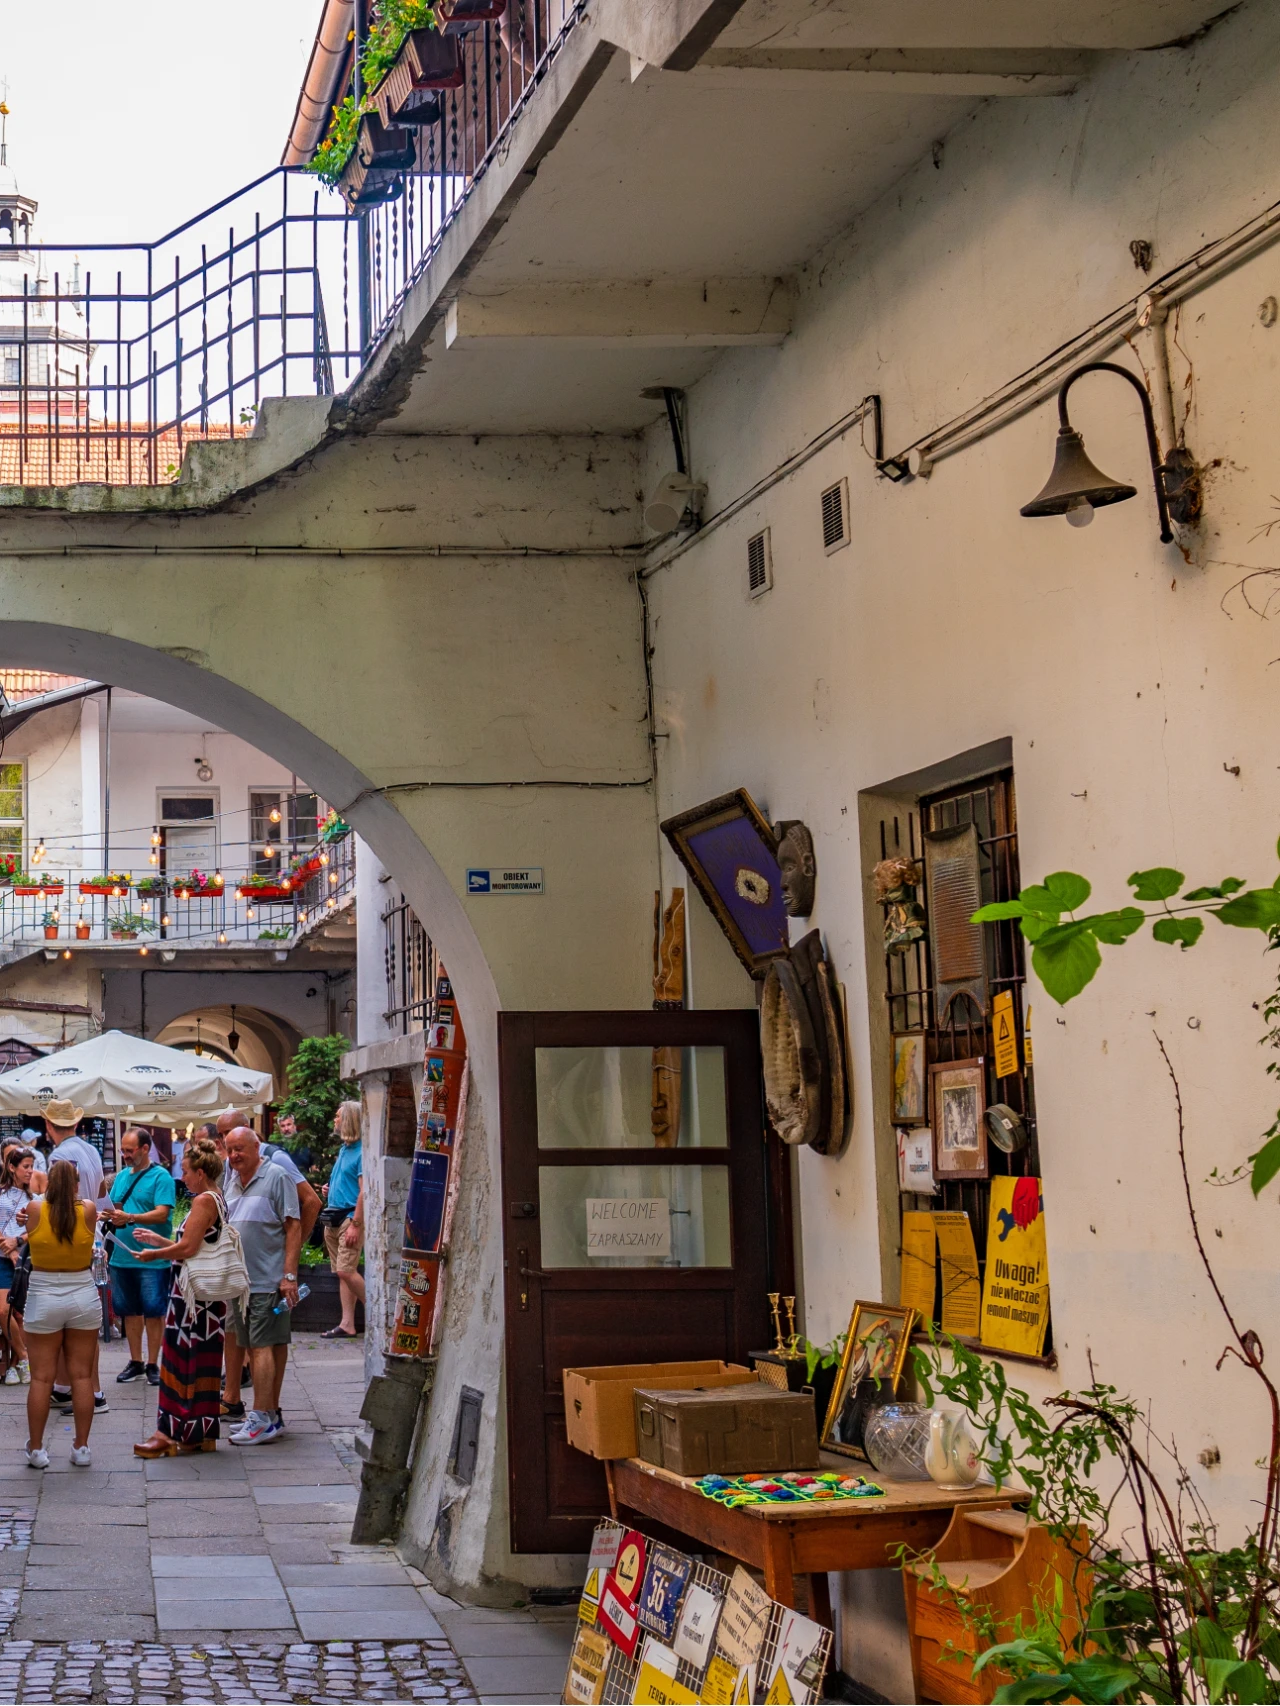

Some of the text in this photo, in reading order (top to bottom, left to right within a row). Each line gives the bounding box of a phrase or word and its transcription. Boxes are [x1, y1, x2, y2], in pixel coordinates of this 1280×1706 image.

[503, 872, 530, 881] OBIEKT
[491, 882, 542, 890] MONITOROWANY
[591, 1202, 660, 1220] WELCOME
[588, 1233, 664, 1247] ZAPRASZAMY
[995, 1258, 1041, 1286] Uwaga!
[990, 1282, 1004, 1299] nie
[986, 1303, 1040, 1327] remont maszyn
[647, 1570, 667, 1613] 56
[648, 1685, 668, 1704] TEREN
